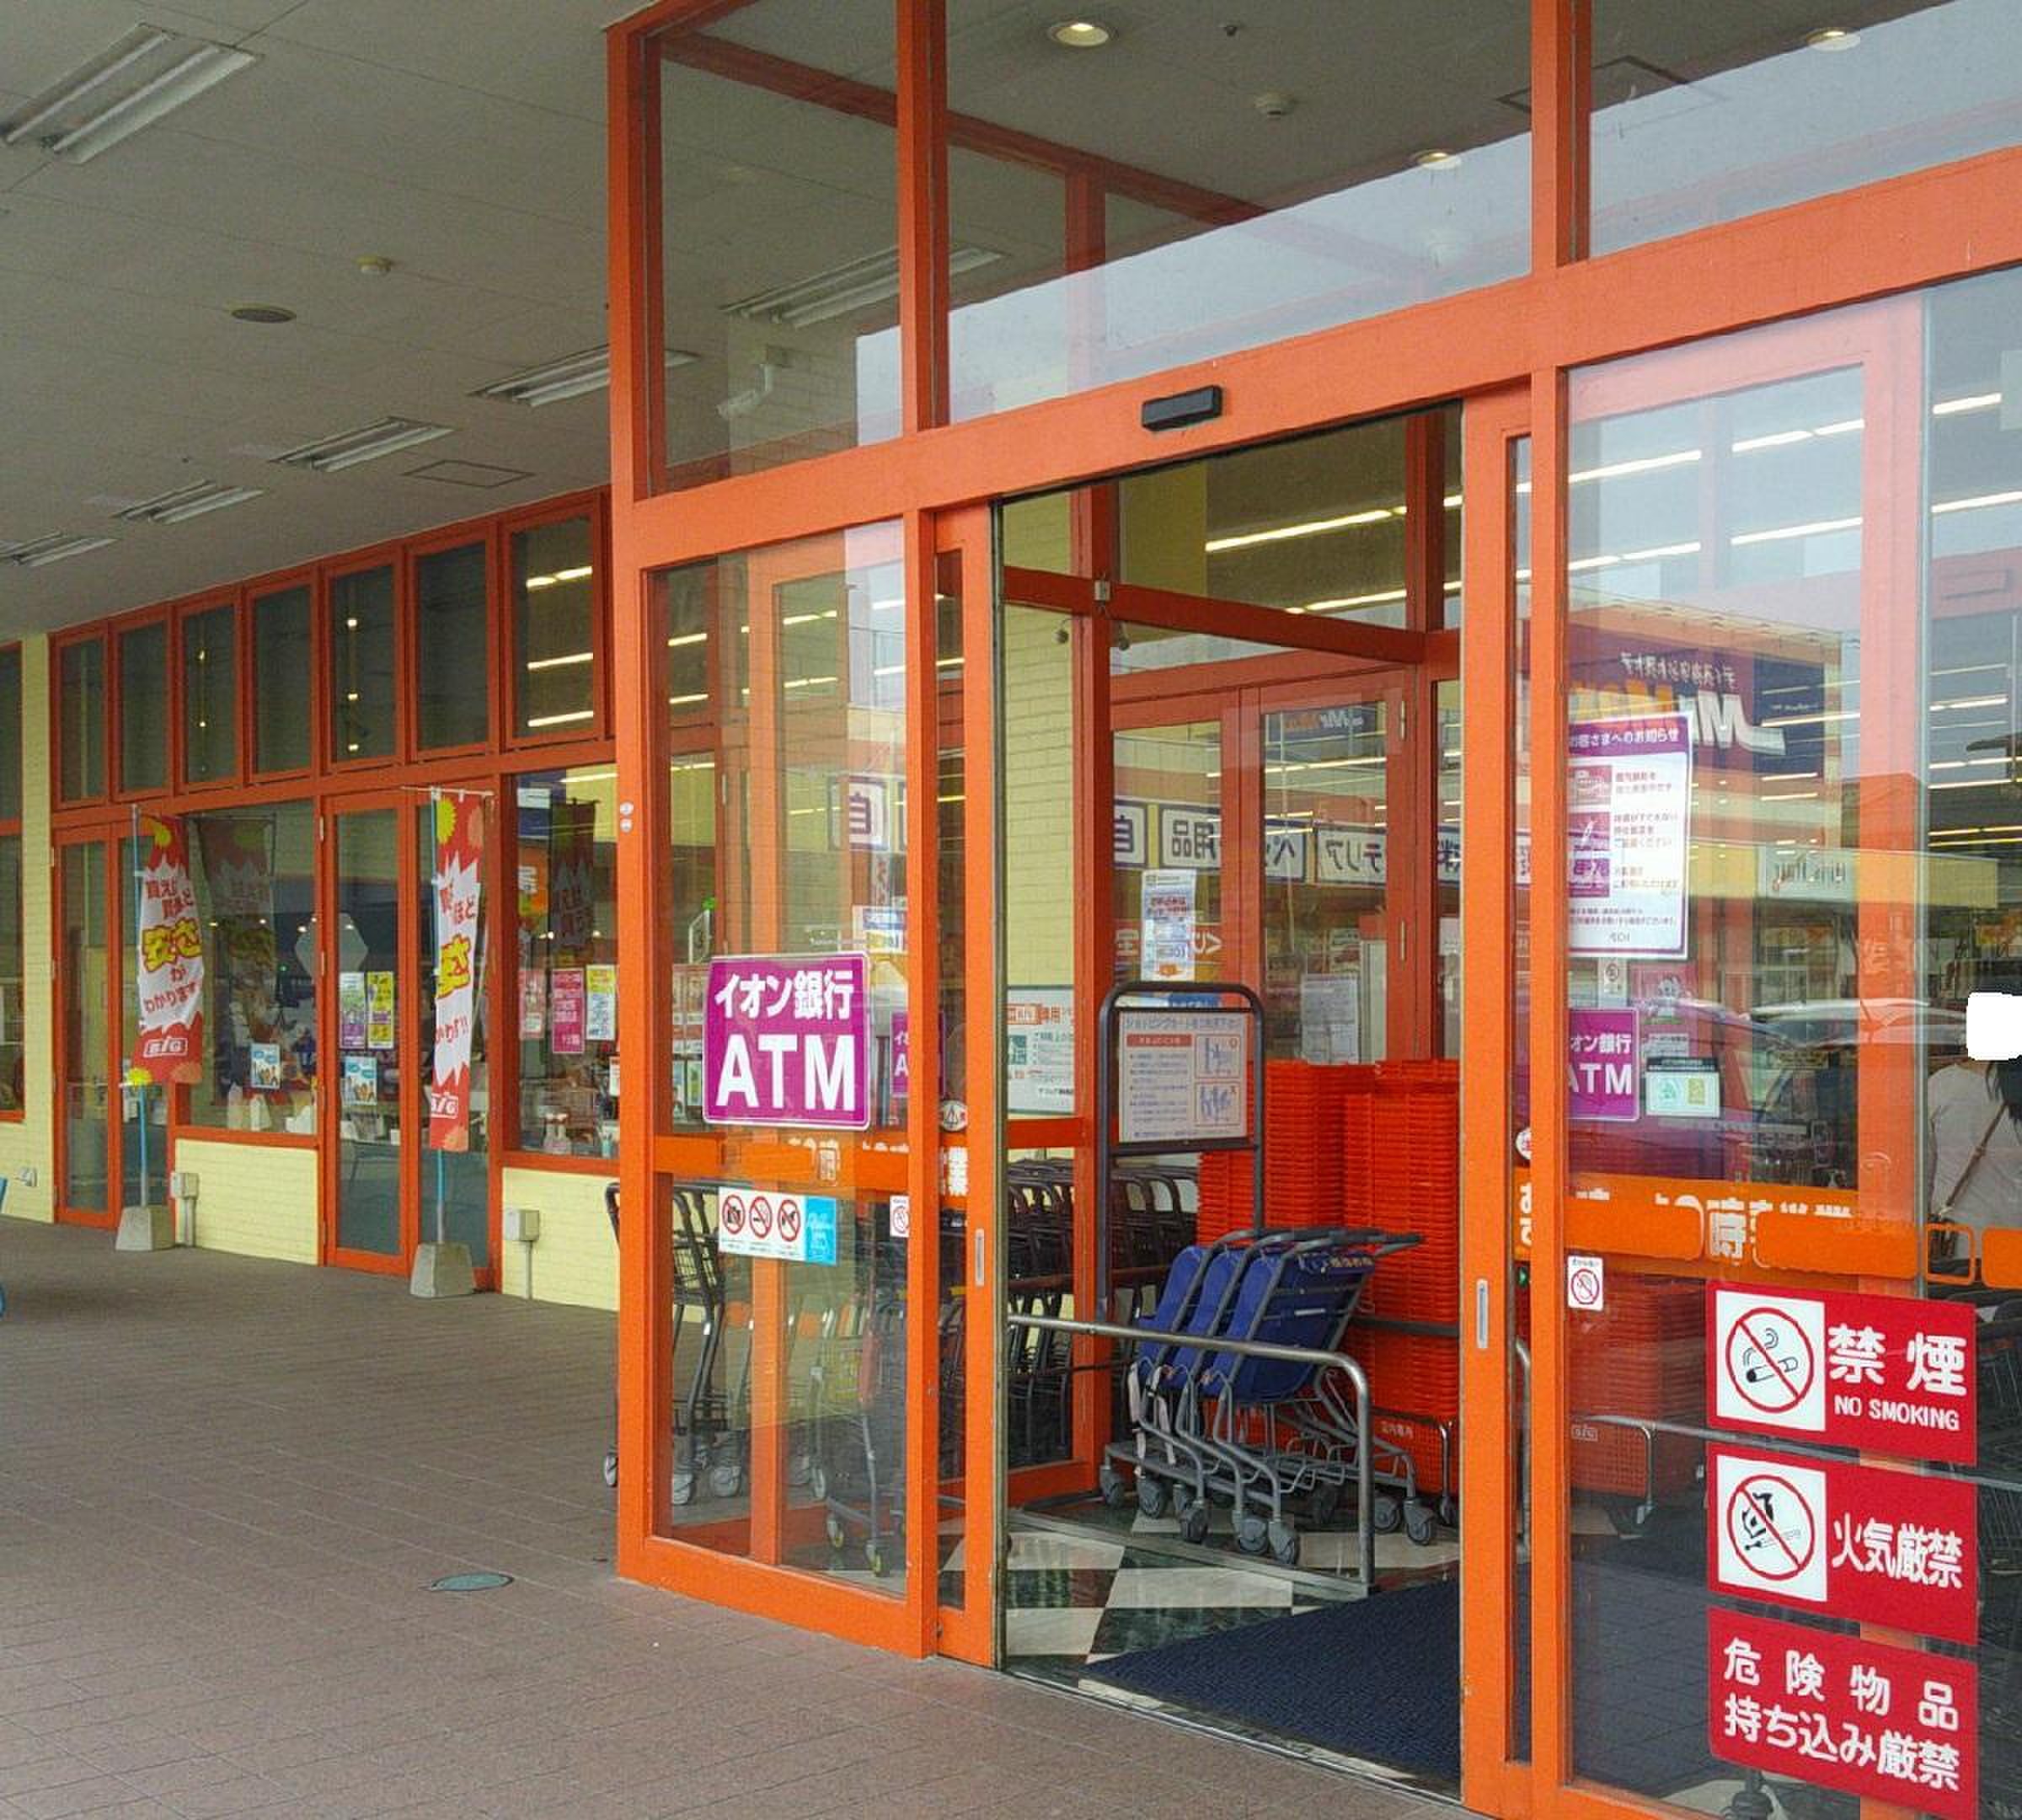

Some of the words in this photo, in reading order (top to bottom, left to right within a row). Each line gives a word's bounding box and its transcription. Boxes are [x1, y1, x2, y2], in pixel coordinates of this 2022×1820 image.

[714, 969, 854, 1020] イオン銀行
[716, 1033, 856, 1111] ATM
[1570, 1033, 1632, 1054] オン銀行
[1827, 1324, 1966, 1397] 禁煙
[1833, 1394, 1863, 1416] NO
[1869, 1398, 1960, 1432] SMOKING
[1831, 1512, 1962, 1590] 火気厳禁
[1723, 1636, 1959, 1732] 危険物品
[1723, 1692, 1960, 1792] 持ち込み厳禁
